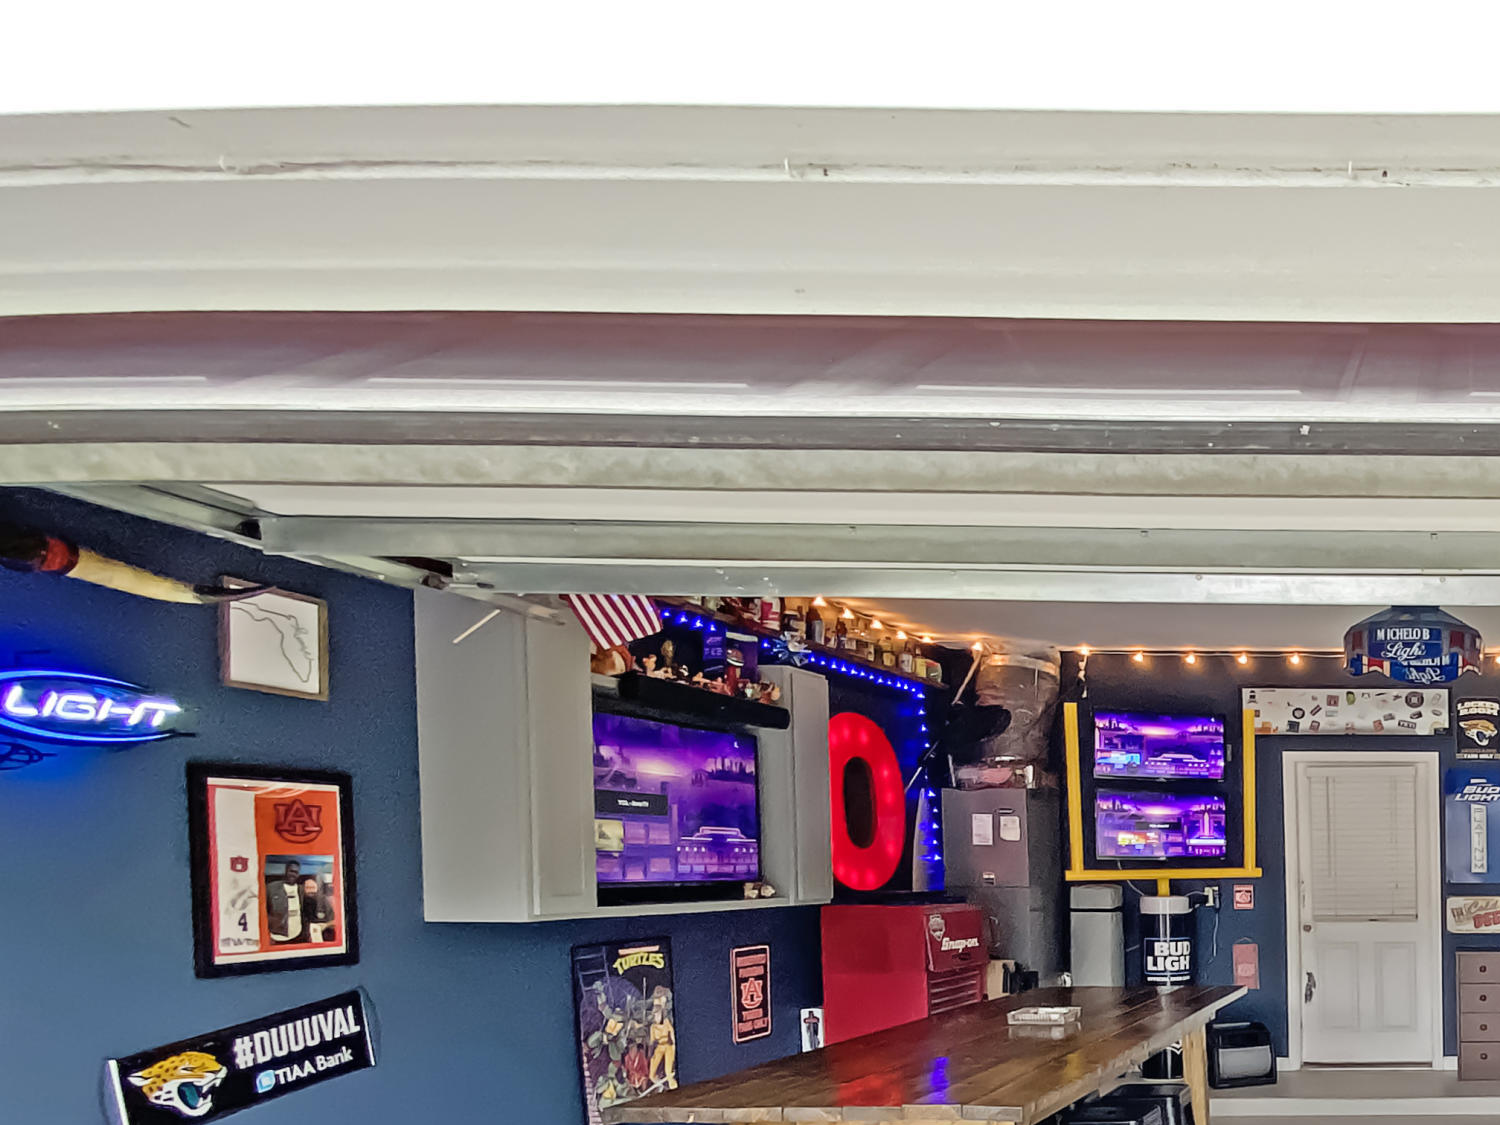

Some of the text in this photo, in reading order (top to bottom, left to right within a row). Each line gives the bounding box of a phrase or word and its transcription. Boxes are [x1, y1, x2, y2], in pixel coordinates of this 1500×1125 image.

[4, 684, 182, 727] LIGHT
[1463, 785, 1500, 794] BUD
[1473, 807, 1486, 870] PLATINUM
[237, 912, 249, 931] 4
[1154, 941, 1191, 956] BUD
[612, 951, 665, 975] TURTLES
[1146, 956, 1190, 971] LIGH
[233, 1005, 361, 1070] #DUUUVAL
[275, 1046, 353, 1085] TIAA Bank
